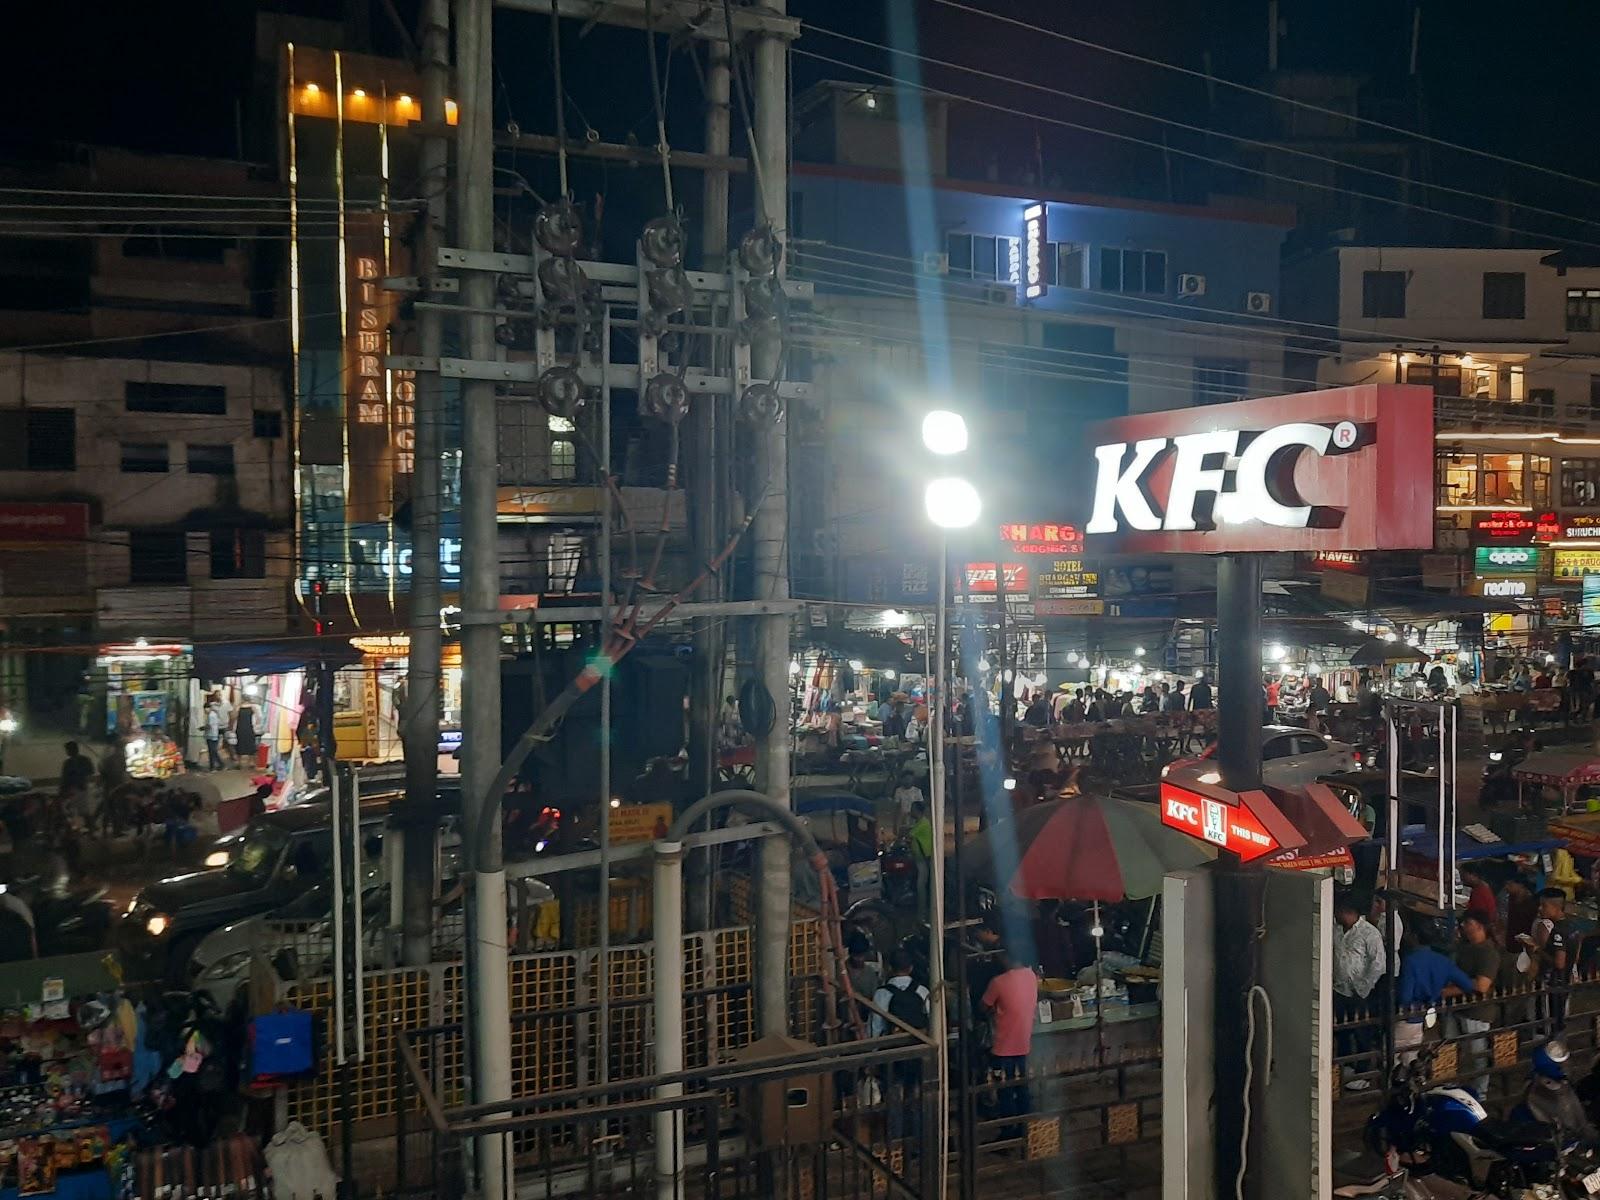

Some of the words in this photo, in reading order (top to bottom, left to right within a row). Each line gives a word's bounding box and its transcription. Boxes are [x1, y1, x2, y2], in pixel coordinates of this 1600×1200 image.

[357, 257, 385, 424] BISHRAM
[1053, 560, 1084, 572] HOTEL
[1483, 579, 1526, 596] realme
[365, 671, 377, 745] PHARMACY
[1167, 799, 1199, 826] KFC
[1207, 829, 1224, 842] KFC
[1231, 824, 1251, 840] THIS
